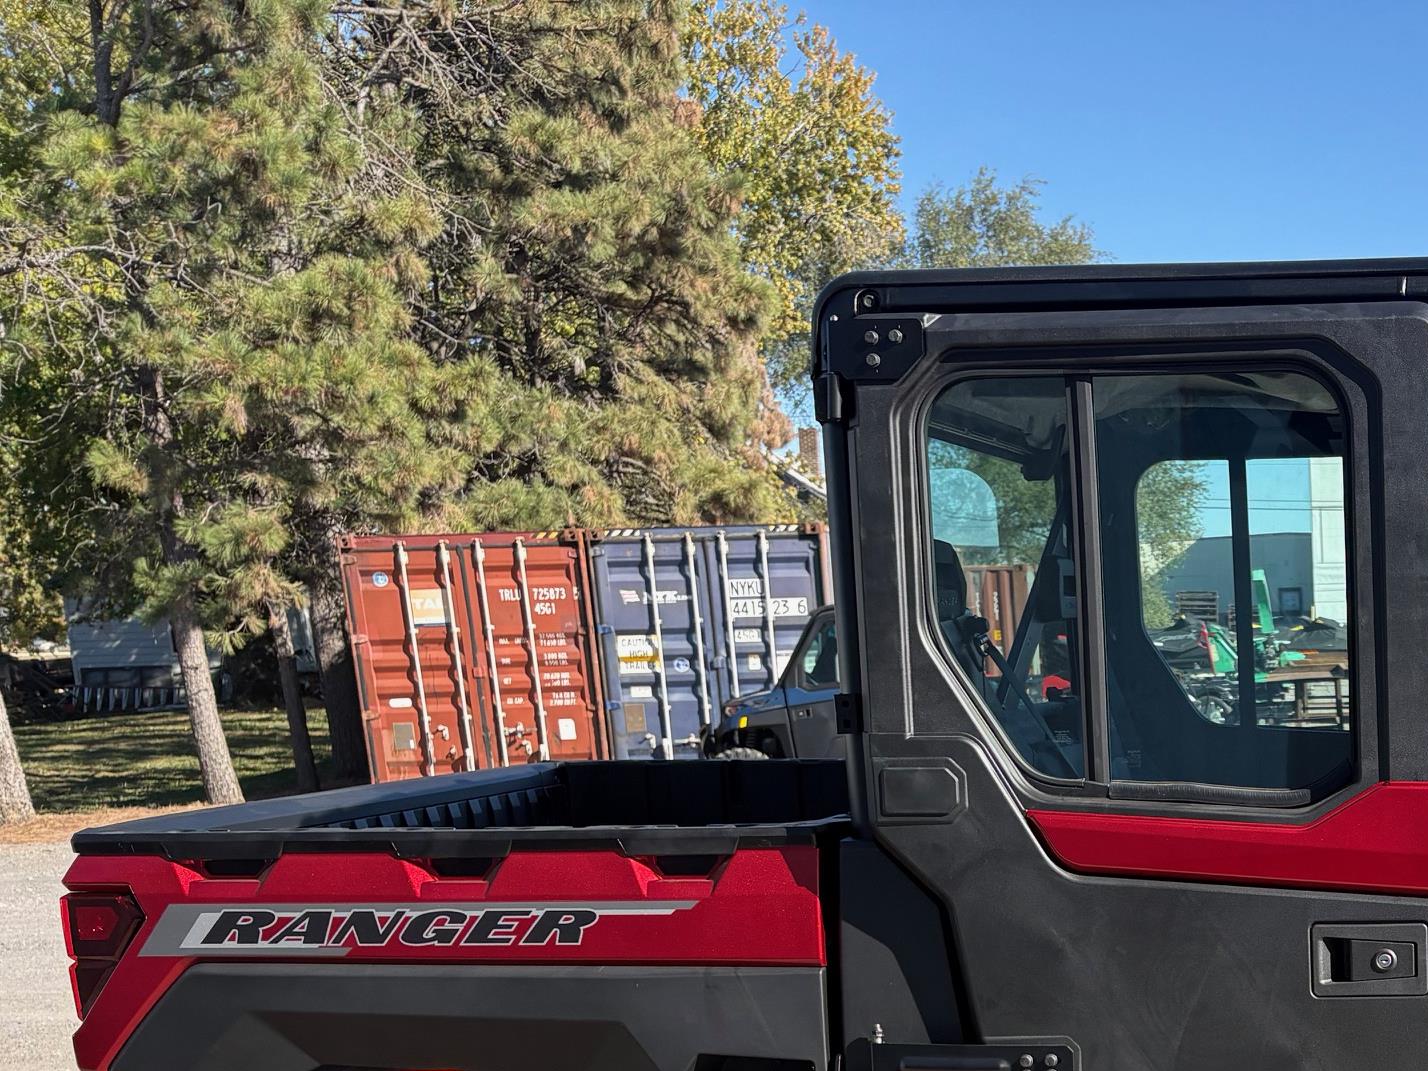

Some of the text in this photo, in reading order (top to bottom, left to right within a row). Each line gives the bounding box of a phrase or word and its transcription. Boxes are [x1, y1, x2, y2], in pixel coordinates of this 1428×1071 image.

[532, 587, 566, 600] 725873
[797, 600, 806, 614] 6
[200, 908, 600, 947] RANGER
